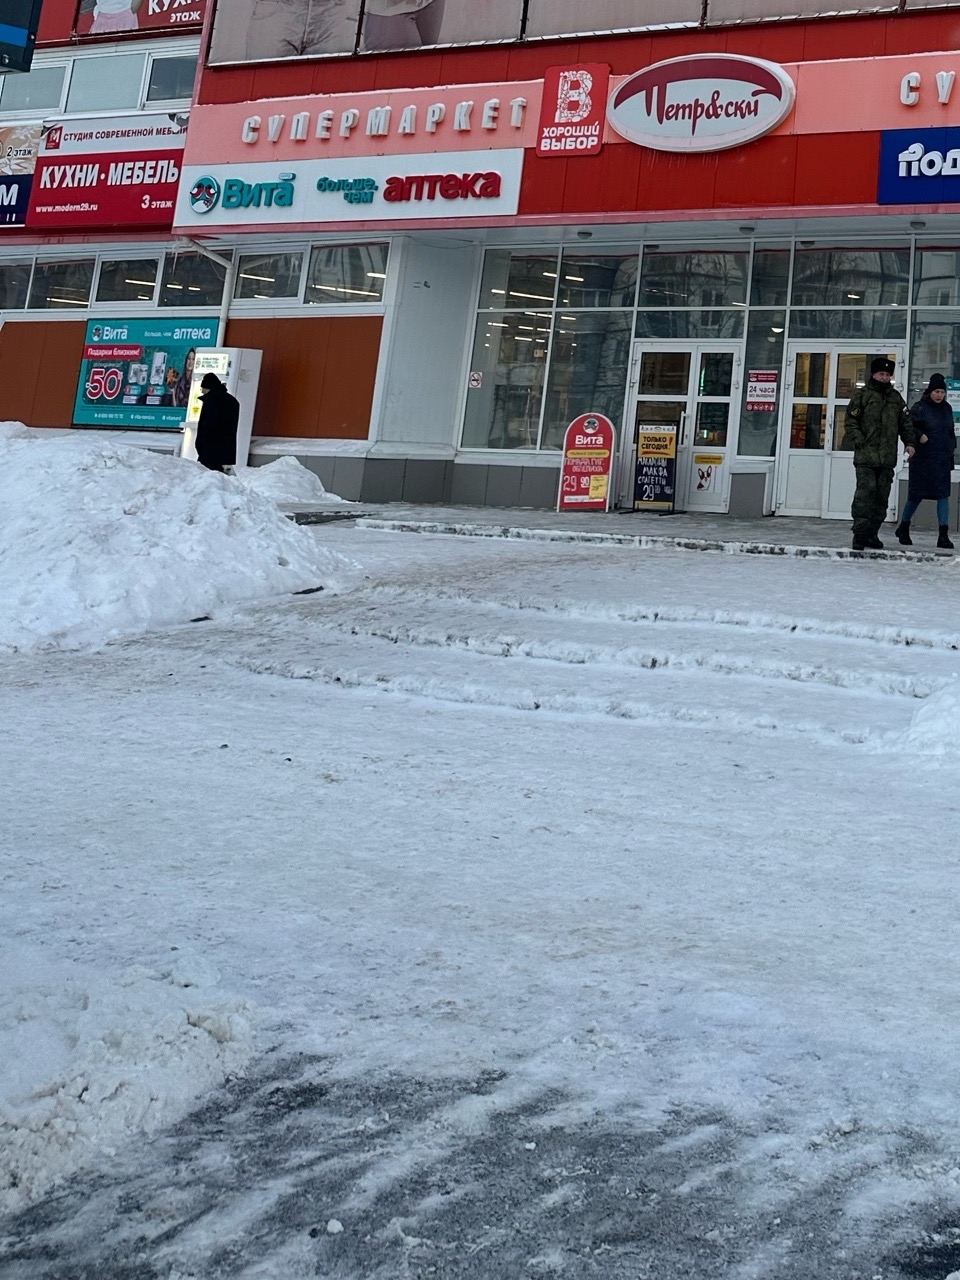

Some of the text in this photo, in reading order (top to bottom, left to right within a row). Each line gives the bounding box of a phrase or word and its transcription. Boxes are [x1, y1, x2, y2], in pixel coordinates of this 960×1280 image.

[170, 10, 201, 23] этаж
[242, 97, 528, 144] СУПЕРМАРКЕТ
[63, 131, 93, 142] СТУДИЯ
[95, 126, 154, 139] СОВРЕМЕННОЙ
[542, 121, 600, 137] ХОРОШИЙ
[540, 137, 598, 151] ВЫБОР
[7, 146, 33, 157] 2 этаж
[40, 160, 179, 188] КУХНИ МЕБЕЛЬ
[222, 179, 294, 209] Вита
[384, 172, 501, 203] аптека
[142, 195, 173, 209] 3 этаж
[344, 190, 374, 204] чем
[103, 327, 128, 340] Вита
[173, 328, 211, 340] аптека
[575, 435, 604, 445] Вита
[643, 467, 668, 477] МАКФА
[563, 476, 577, 491] 29
[642, 485, 655, 500] 29
